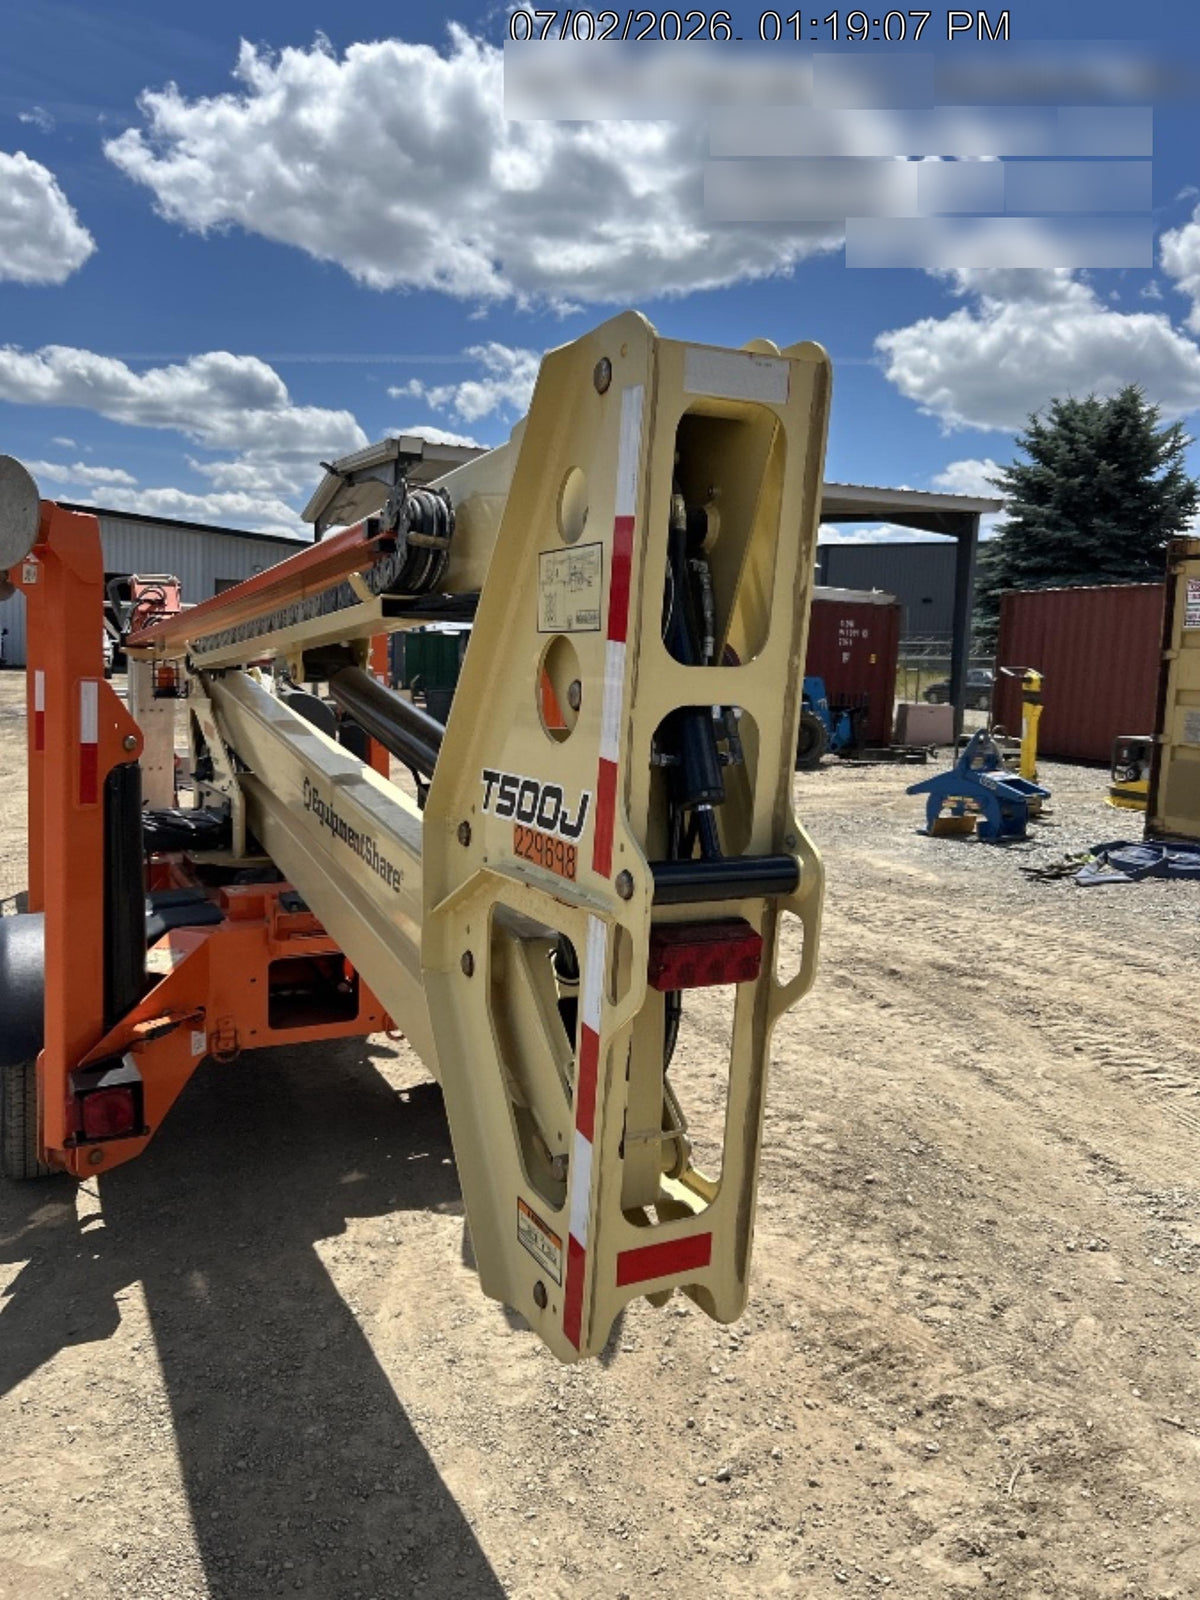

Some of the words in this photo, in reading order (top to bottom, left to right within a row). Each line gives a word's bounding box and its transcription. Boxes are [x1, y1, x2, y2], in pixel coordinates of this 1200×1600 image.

[311, 787, 401, 893] EquipmentShare
[481, 768, 591, 841] T500J
[513, 824, 577, 880] 229698
